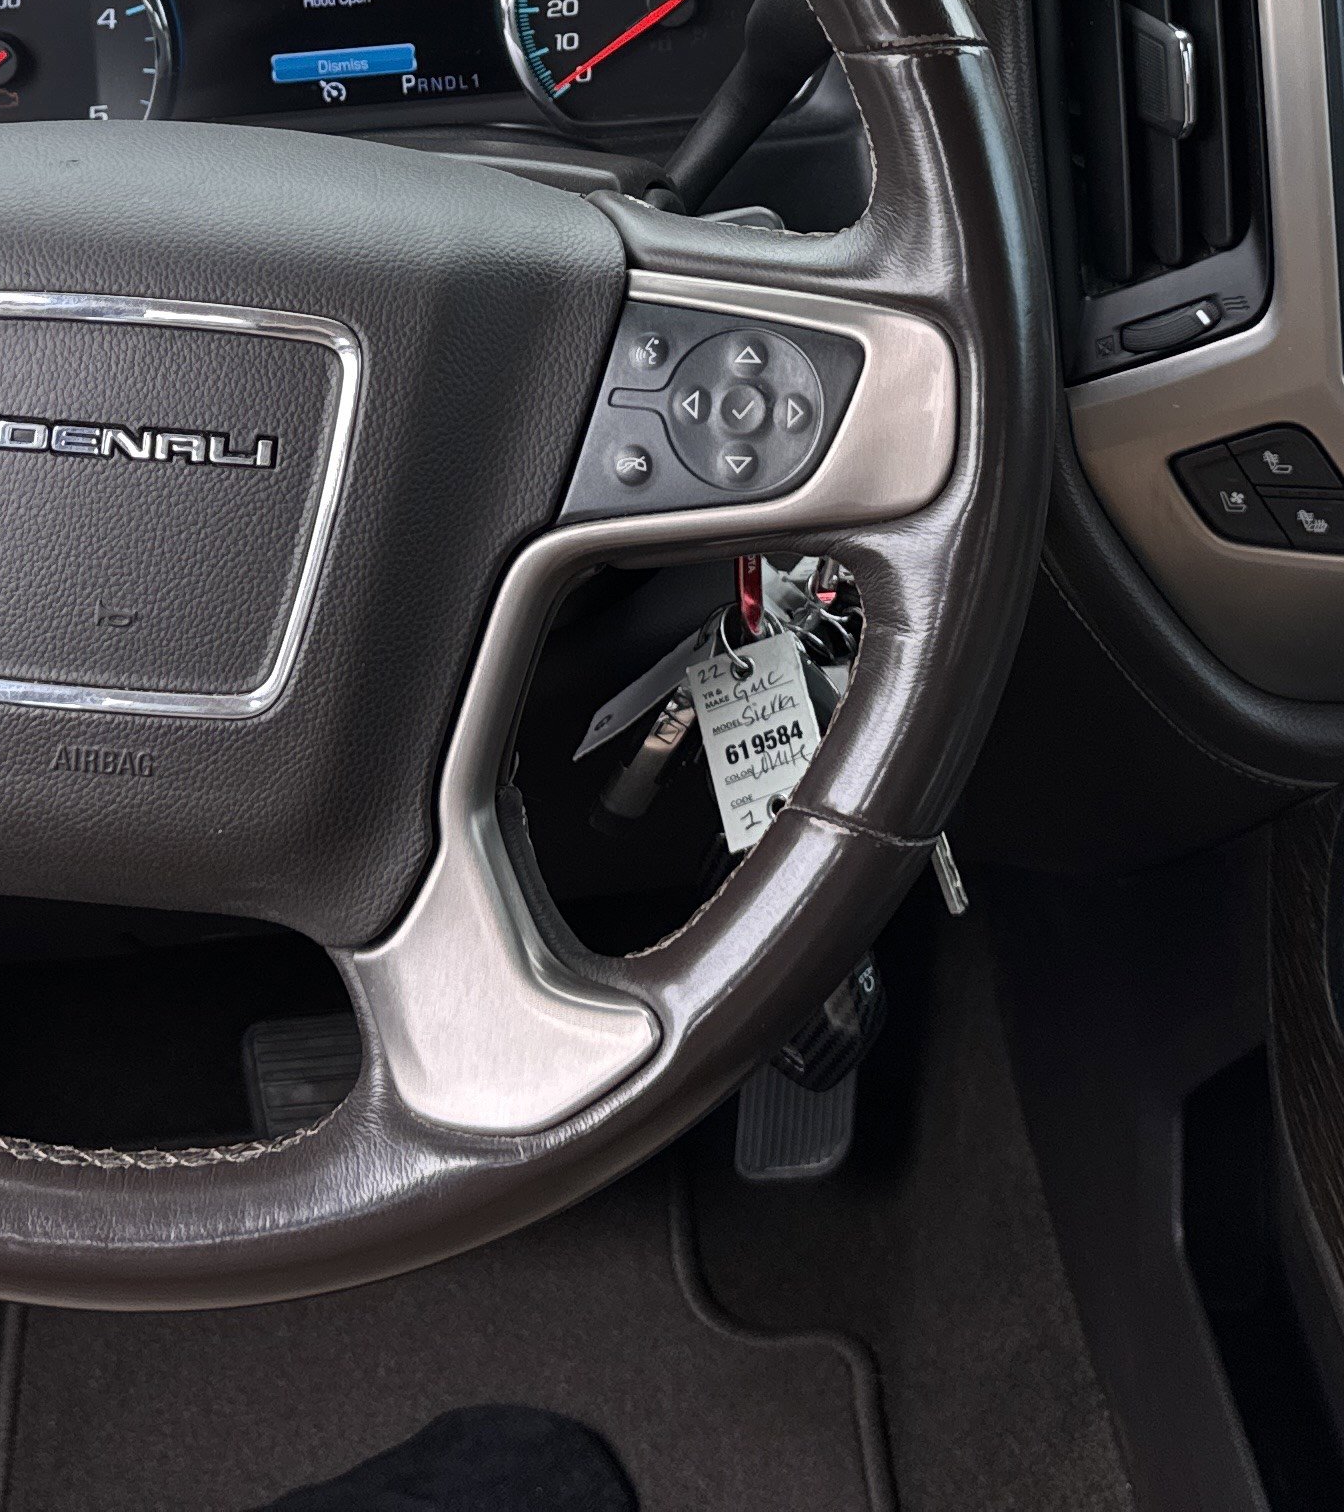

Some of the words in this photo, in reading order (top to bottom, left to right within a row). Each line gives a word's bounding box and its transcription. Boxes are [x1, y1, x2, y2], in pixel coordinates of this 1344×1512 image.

[96, 8, 118, 30] 4
[554, 32, 579, 51] 10
[317, 58, 369, 75] Dismiss
[733, 670, 784, 702] GMC
[705, 695, 730, 709] MAKE
[712, 719, 741, 735] MODEL
[725, 720, 803, 765] 619584
[54, 744, 155, 778] AIRBAG
[730, 793, 754, 809] CODE
